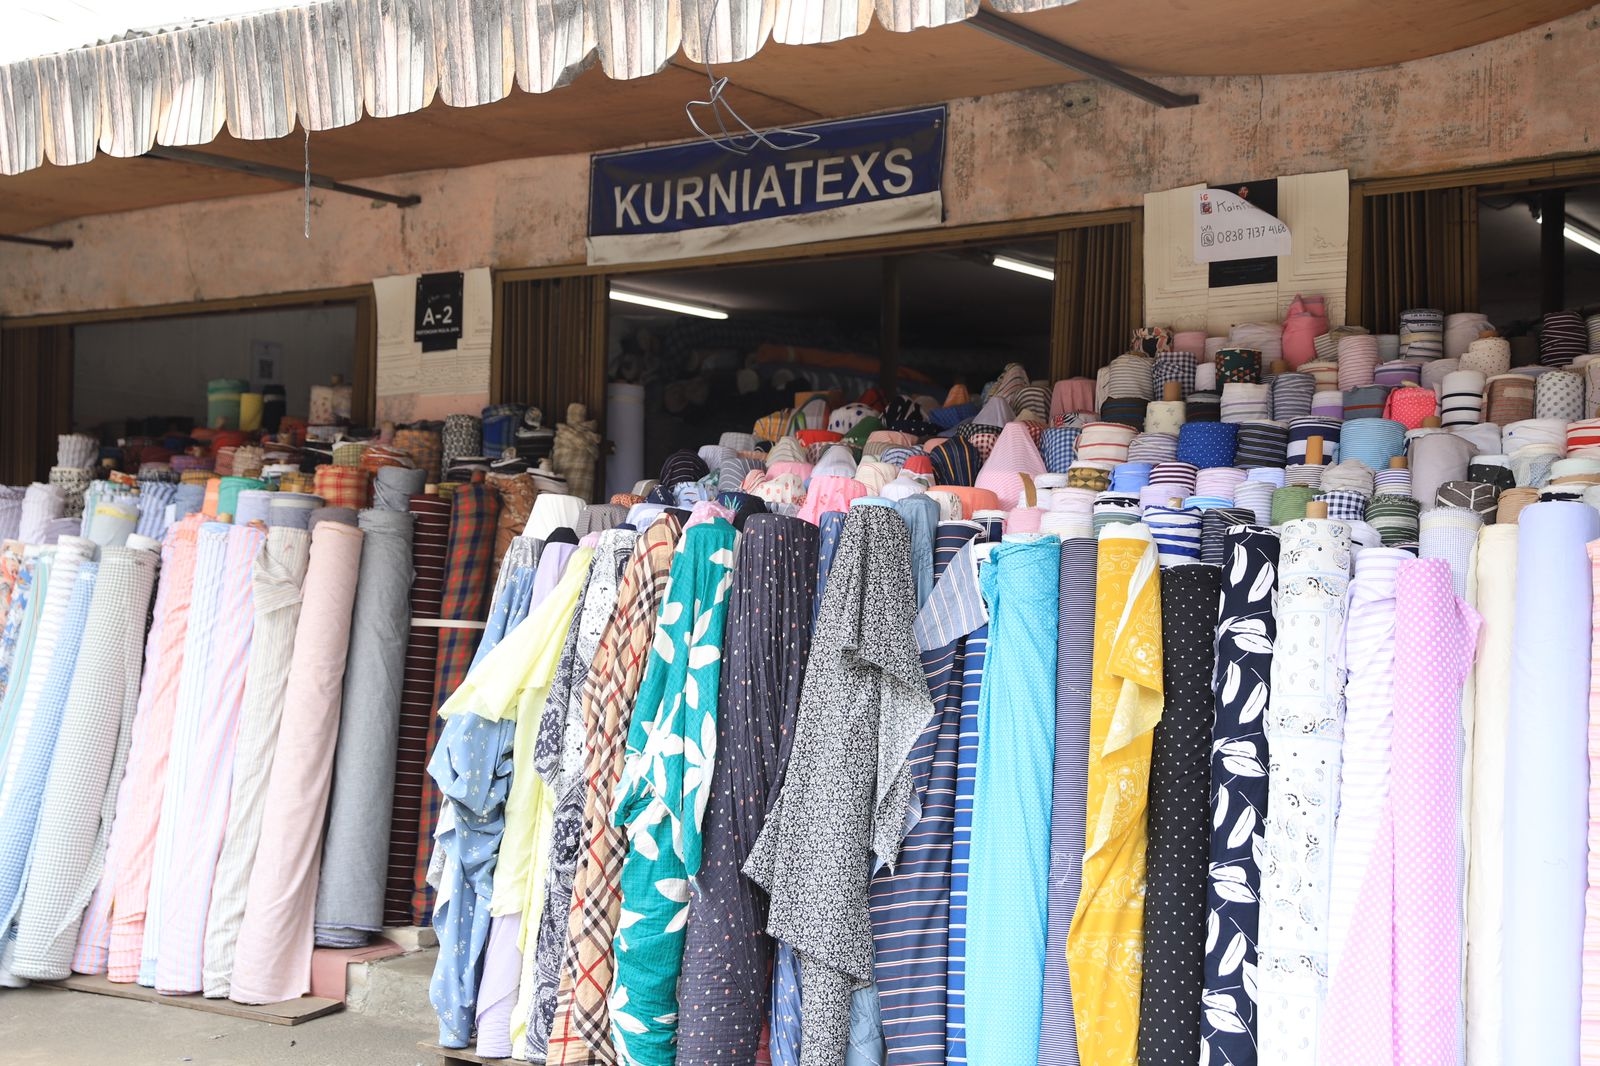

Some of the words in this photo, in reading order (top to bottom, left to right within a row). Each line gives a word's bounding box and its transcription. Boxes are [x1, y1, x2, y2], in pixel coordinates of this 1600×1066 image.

[614, 147, 914, 229] KURNIATEXS
[1217, 228, 1244, 243] 0838
[1247, 226, 1266, 239] 7137
[422, 305, 453, 326] A-2
